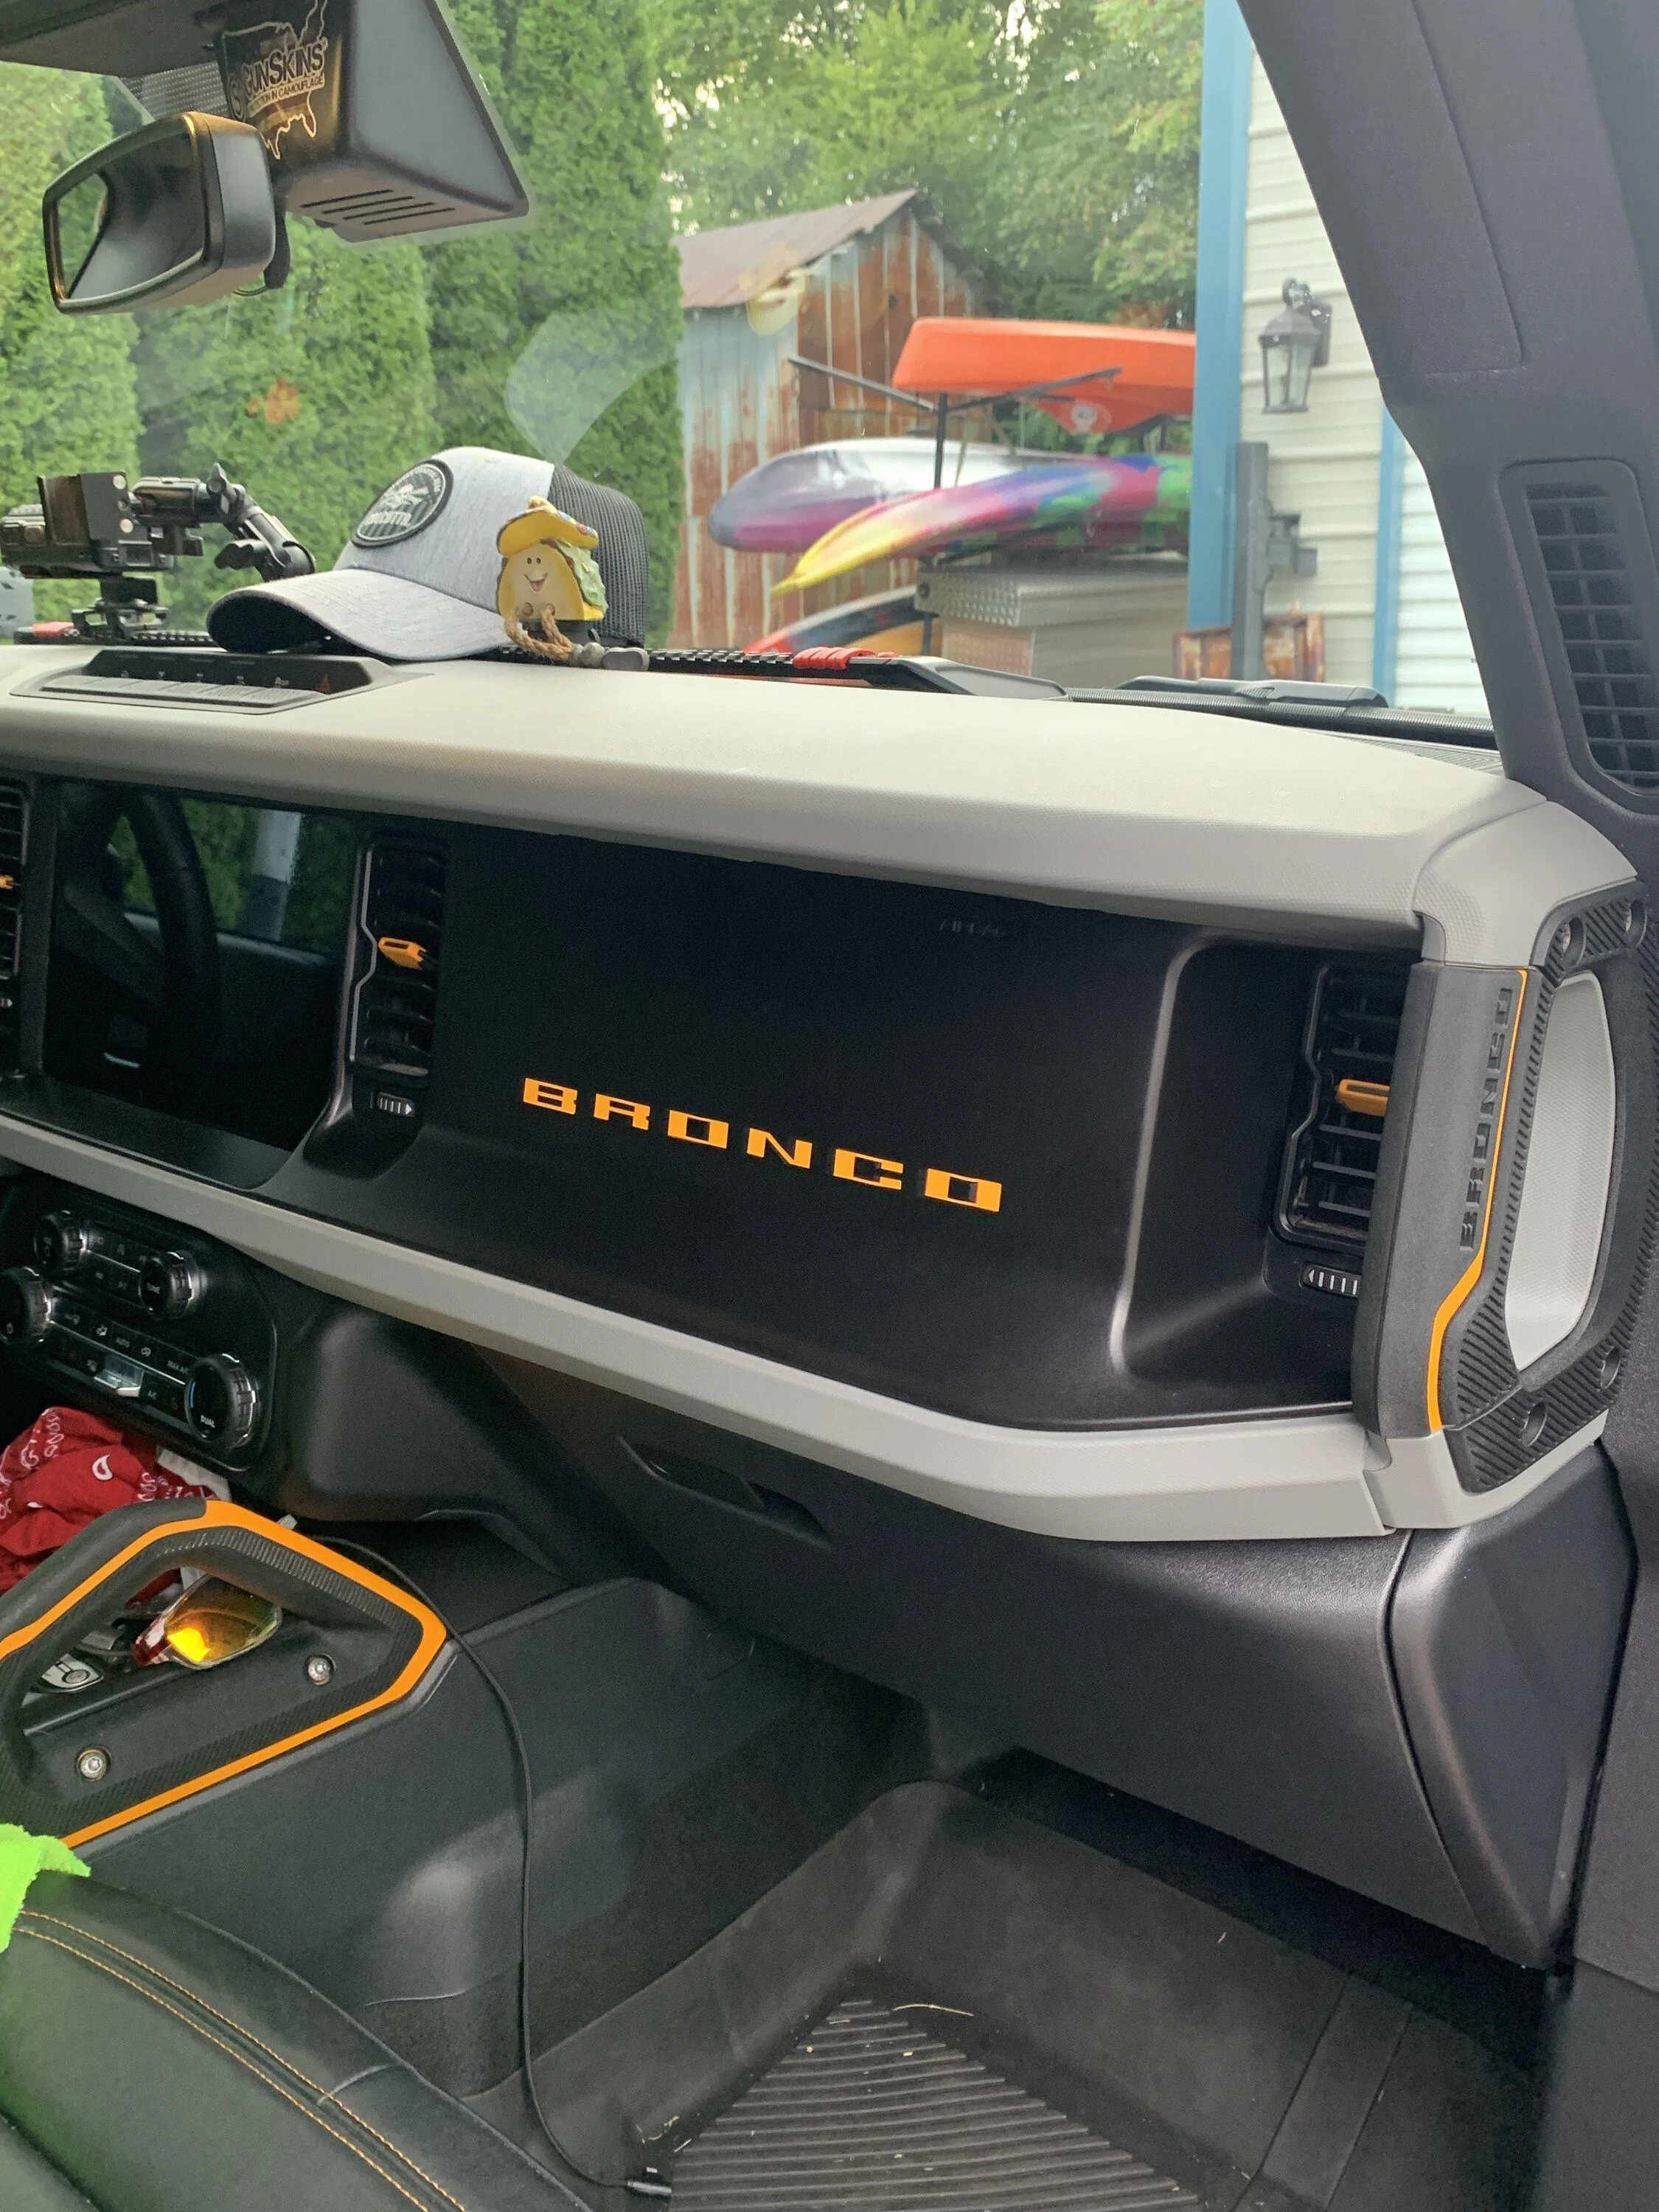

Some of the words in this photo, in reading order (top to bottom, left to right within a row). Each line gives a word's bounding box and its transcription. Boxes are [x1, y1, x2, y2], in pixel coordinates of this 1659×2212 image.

[278, 76, 323, 97] CAMOUFLAGE
[523, 1077, 1002, 1212] BRONCO
[1460, 987, 1513, 1251] BRONCO
